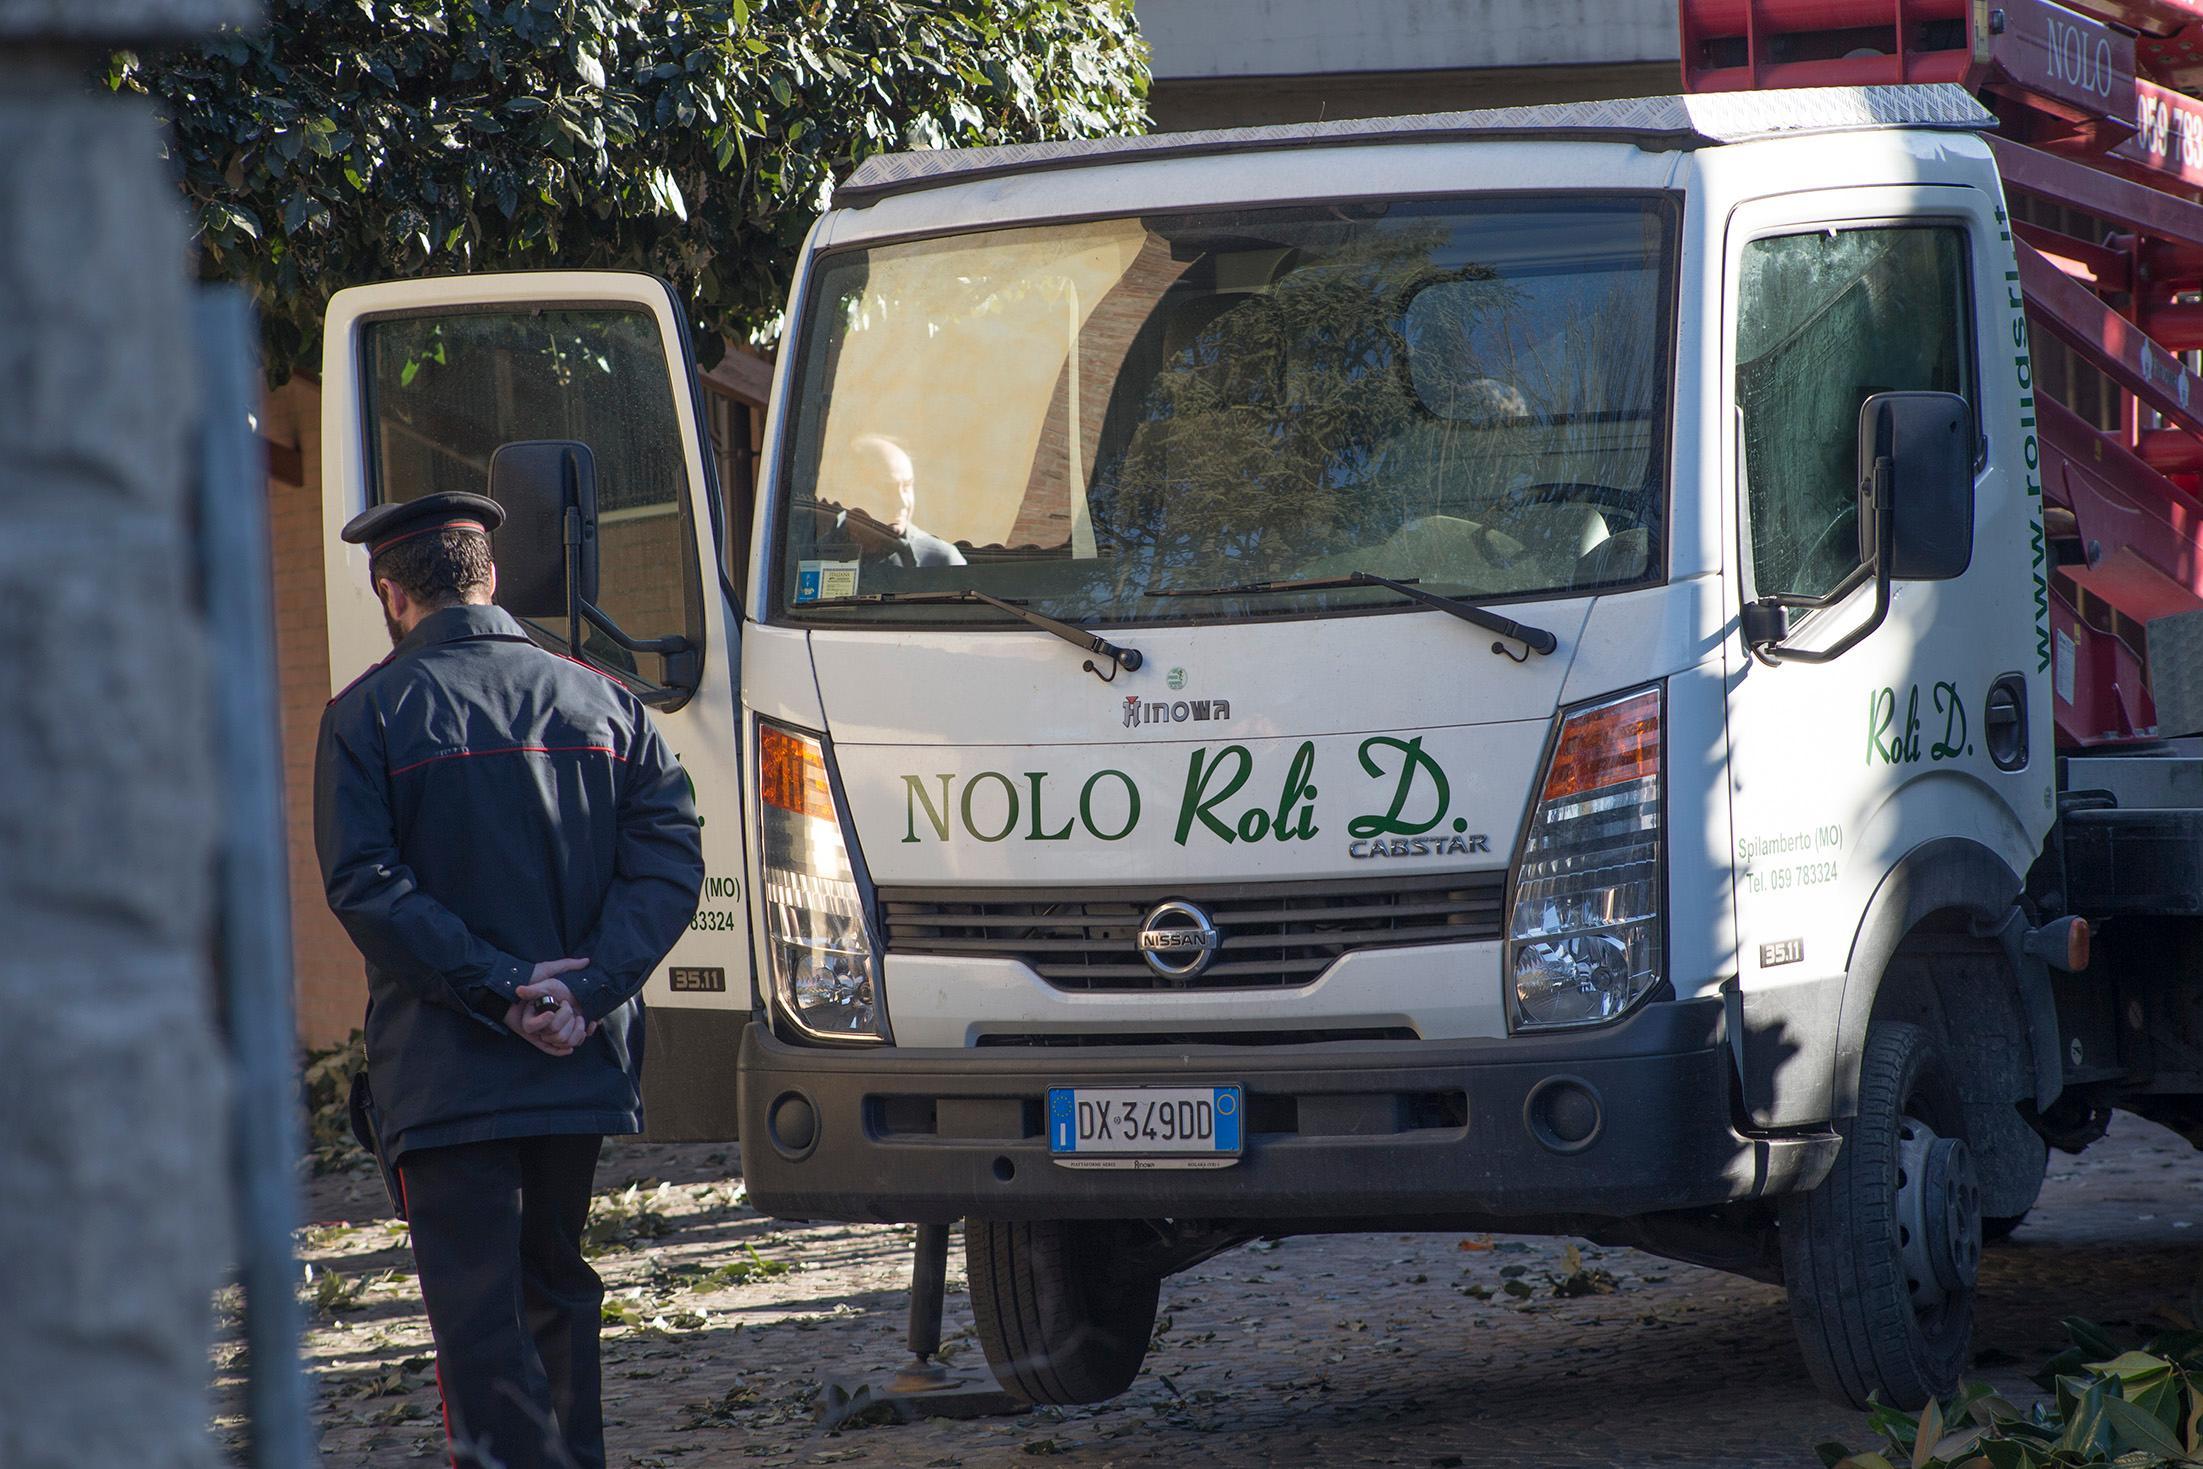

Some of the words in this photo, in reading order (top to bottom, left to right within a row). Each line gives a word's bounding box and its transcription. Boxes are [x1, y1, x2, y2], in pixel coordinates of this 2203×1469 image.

[2047, 17, 2112, 97] NOLO
[2137, 94, 2168, 157] 059
[1866, 683, 1921, 767] Roli
[1931, 680, 1973, 761] D.
[900, 769, 1141, 843] NOLO
[1174, 740, 1319, 847] Roli
[1347, 735, 1468, 840] D.
[1348, 833, 1490, 859] CABSTAR
[1738, 831, 1812, 864] Spilamberto
[1815, 823, 1843, 854] (MO)
[704, 877, 741, 903] (MO)
[1746, 871, 1767, 894] Tel.
[1771, 867, 1792, 890] 059
[1796, 860, 1838, 888] 783324
[1143, 934, 1206, 947] NISSAN
[1765, 940, 1801, 965] 35.11
[675, 969, 719, 989] 35.11
[1078, 1100, 1112, 1140] DX
[1122, 1100, 1213, 1141] 349DD
